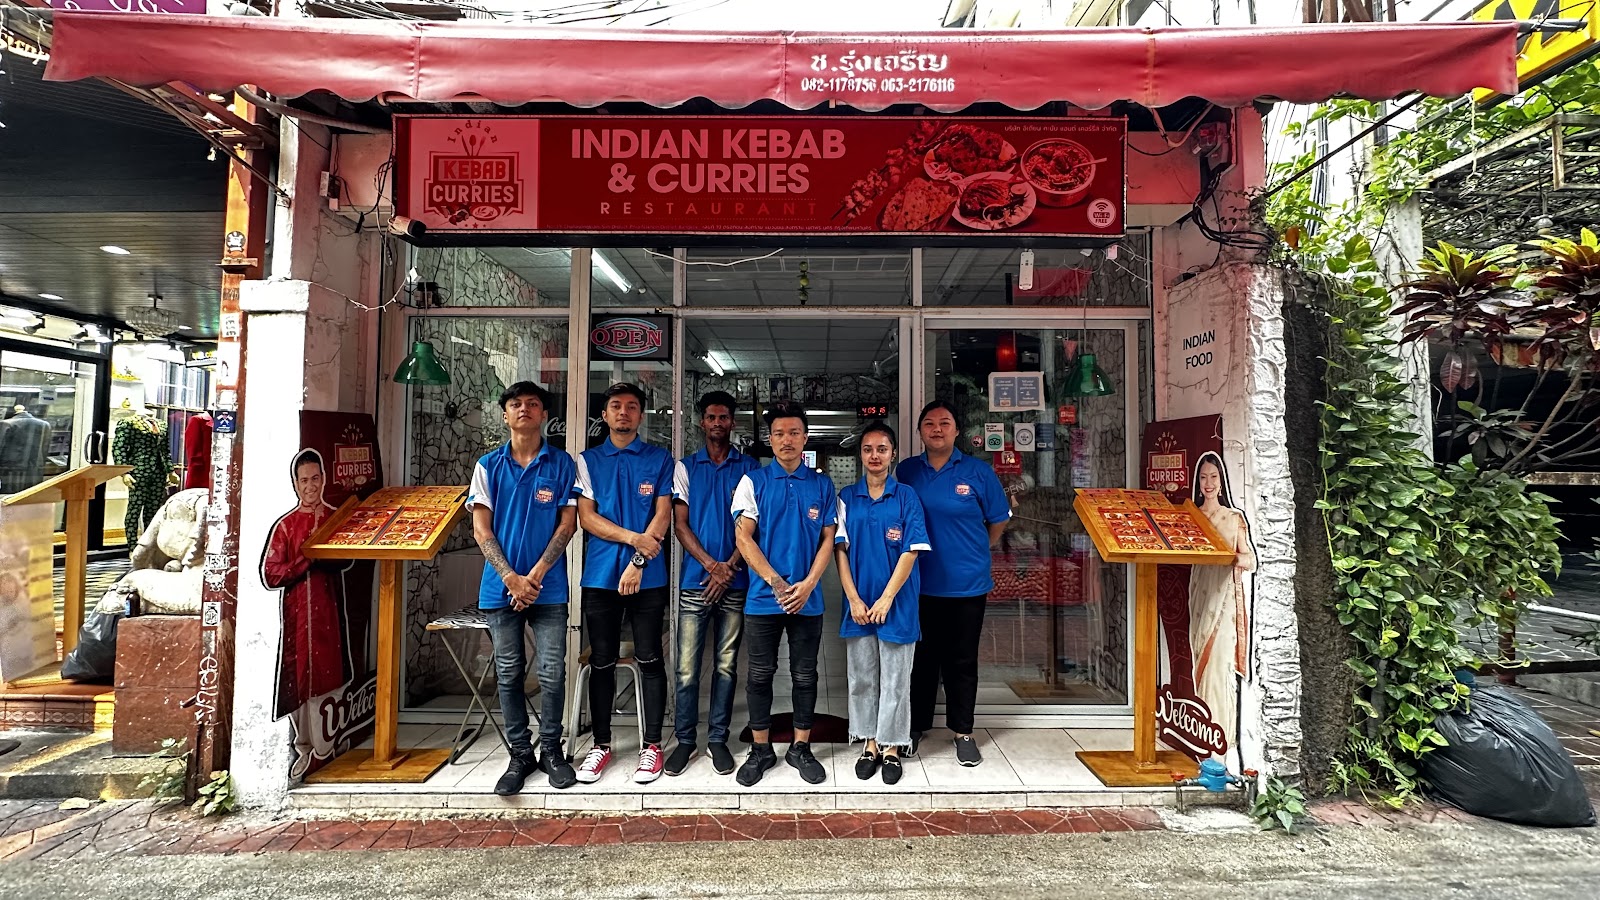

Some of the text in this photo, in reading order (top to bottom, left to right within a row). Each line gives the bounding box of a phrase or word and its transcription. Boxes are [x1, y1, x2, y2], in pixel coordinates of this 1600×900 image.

[447, 120, 498, 143] Indian
[571, 128, 847, 159] INDIAN KEBAB
[443, 160, 506, 180] KEBAB
[607, 162, 810, 194] & CURRIES
[432, 185, 515, 203] CURRIES
[600, 202, 817, 216] RESTAURANT
[590, 327, 662, 347] OPEN
[1183, 329, 1215, 350] INDIAN
[1186, 351, 1213, 369] FOOD
[337, 463, 373, 477] CURRIES
[1150, 470, 1185, 482] CURRIES
[1003, 482, 1025, 497] PEN
[1156, 690, 1223, 749] Welcome
